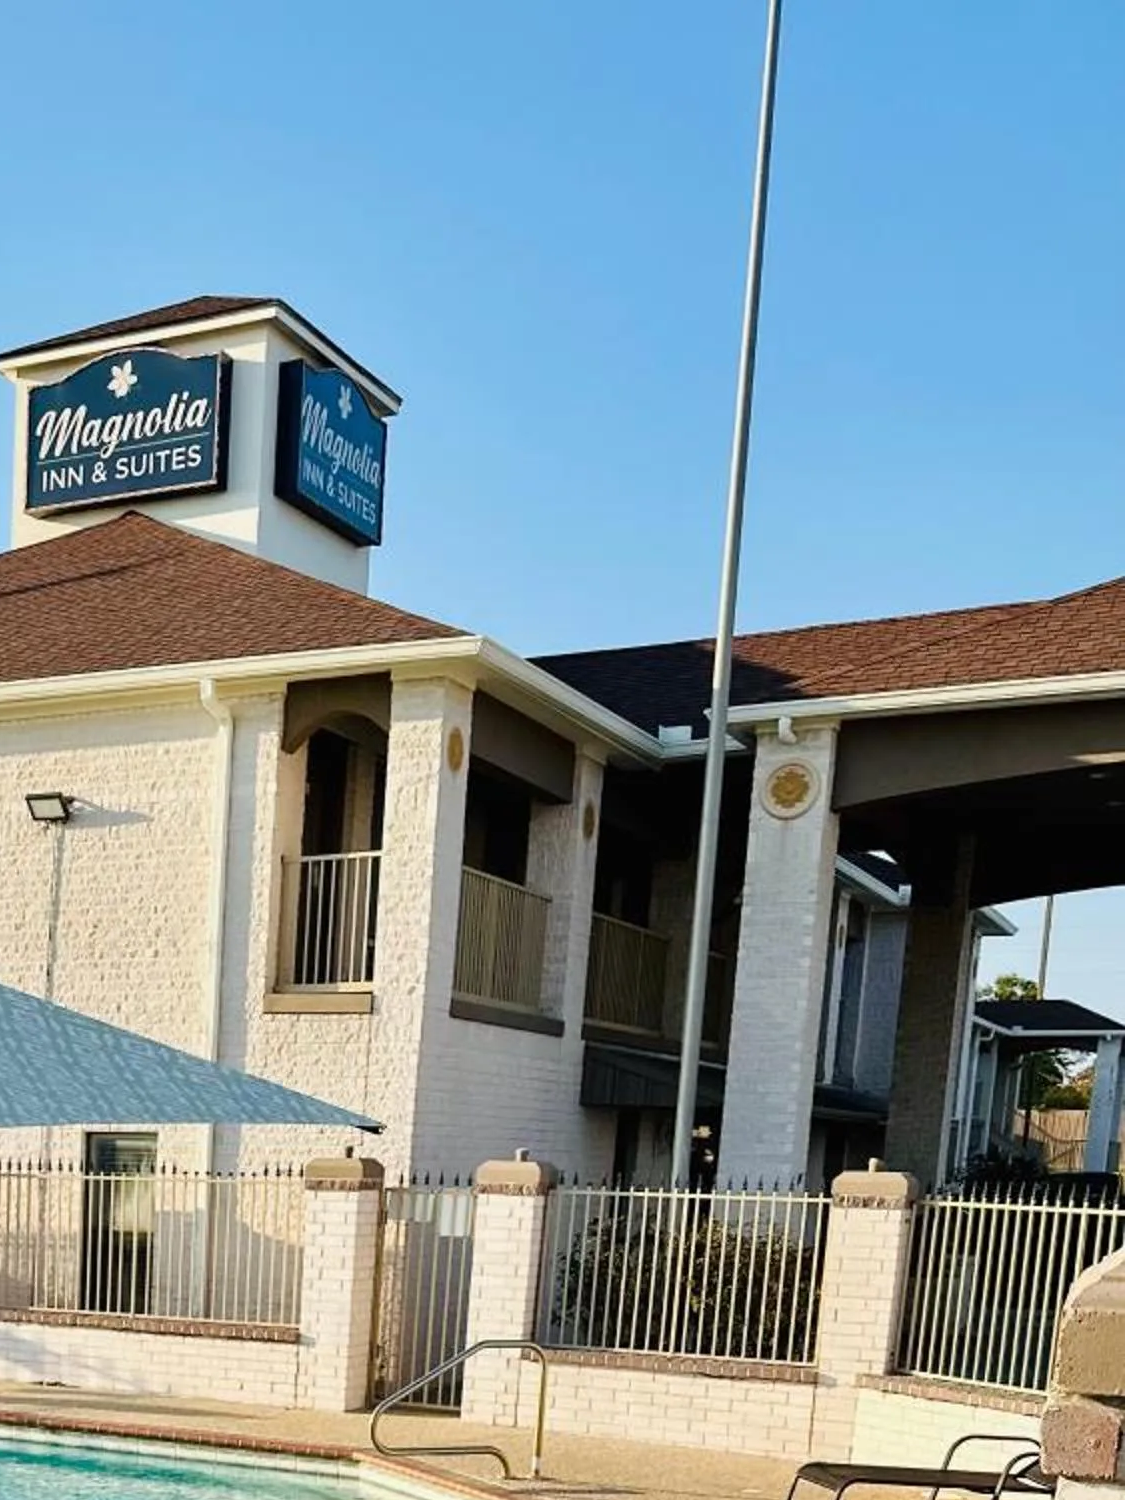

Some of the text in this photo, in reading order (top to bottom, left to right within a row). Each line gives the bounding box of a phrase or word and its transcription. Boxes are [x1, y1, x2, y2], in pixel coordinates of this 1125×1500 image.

[35, 391, 212, 460] Magnolia
[301, 393, 381, 488] Magnolia
[42, 444, 202, 492] INN & SUITES
[302, 458, 376, 524] INN & SUITES
